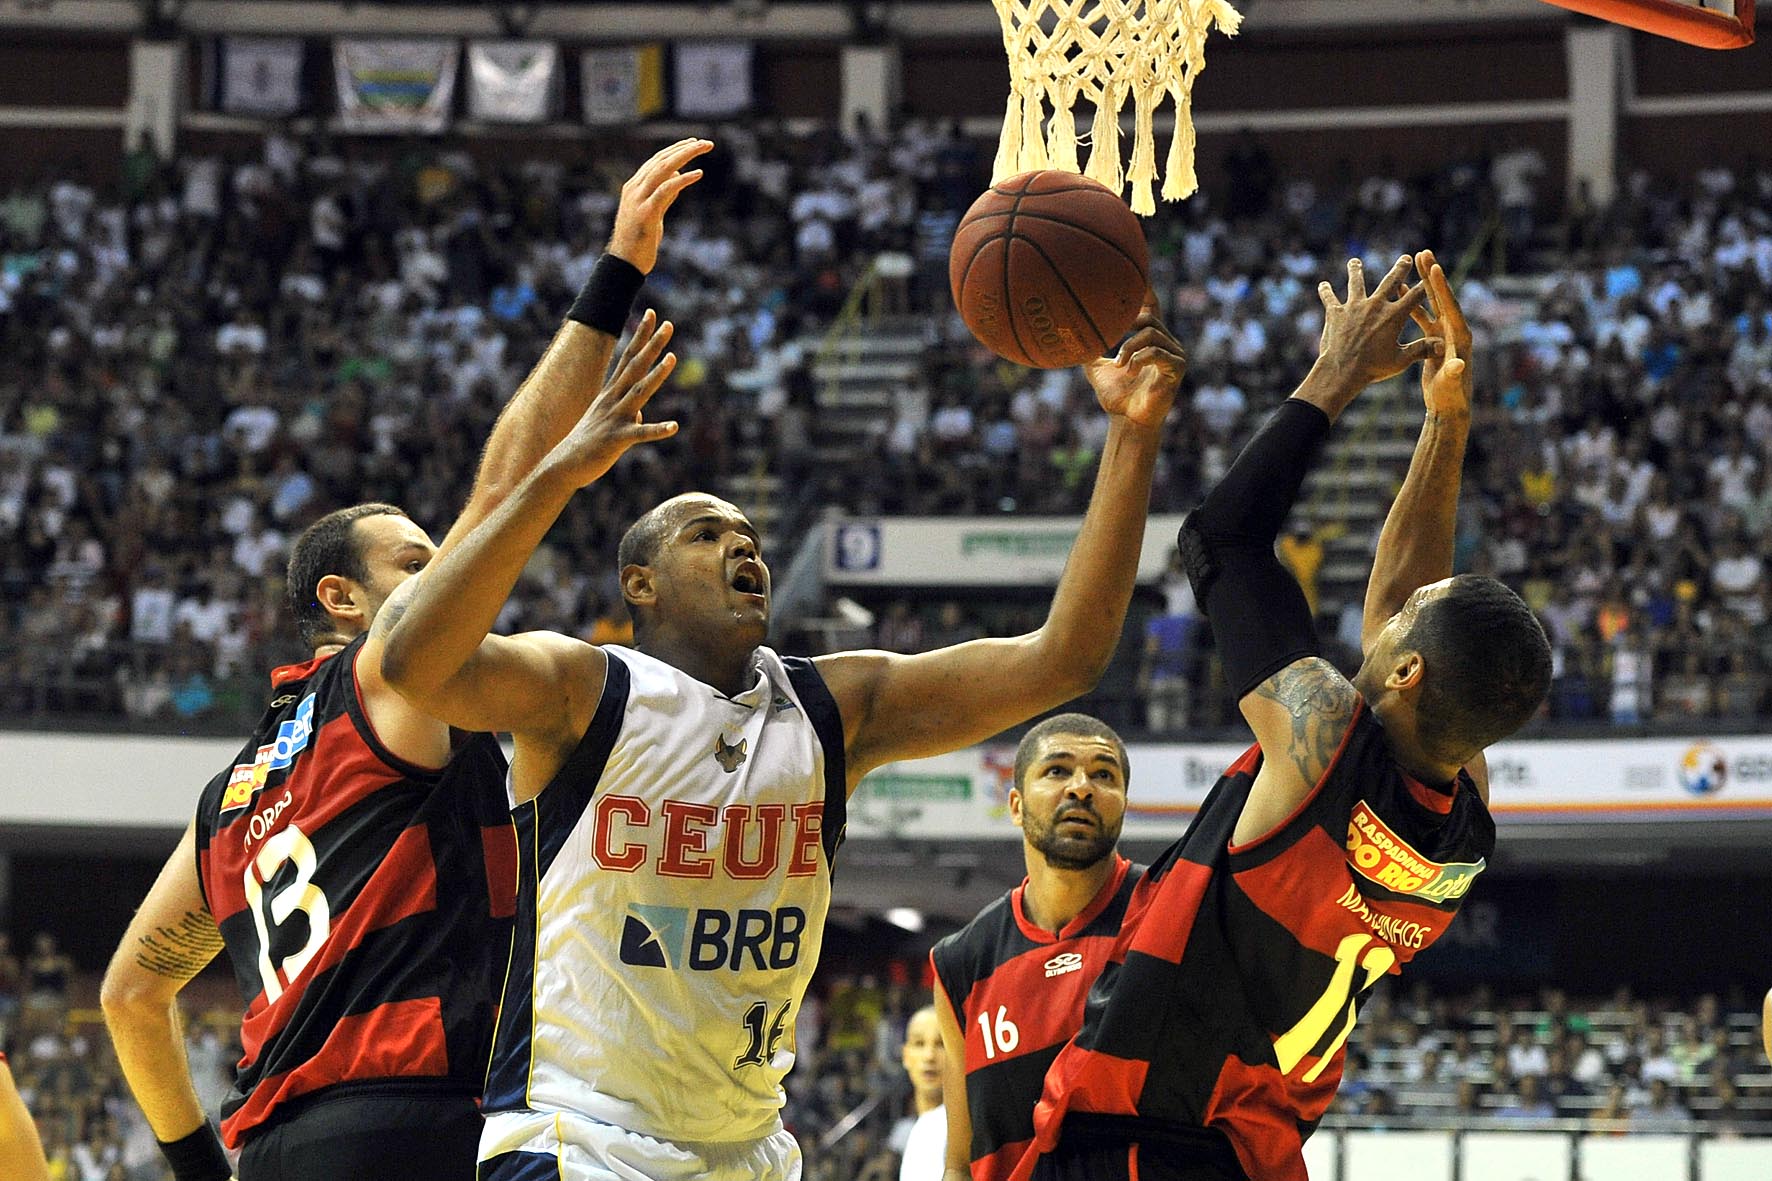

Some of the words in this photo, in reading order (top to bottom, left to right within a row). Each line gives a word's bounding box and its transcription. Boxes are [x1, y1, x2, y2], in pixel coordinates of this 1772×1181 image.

[1354, 811, 1436, 880] RASPADINHA
[1376, 860, 1423, 891] RIO
[688, 906, 806, 971] BRB
[977, 1004, 1020, 1059] 16
